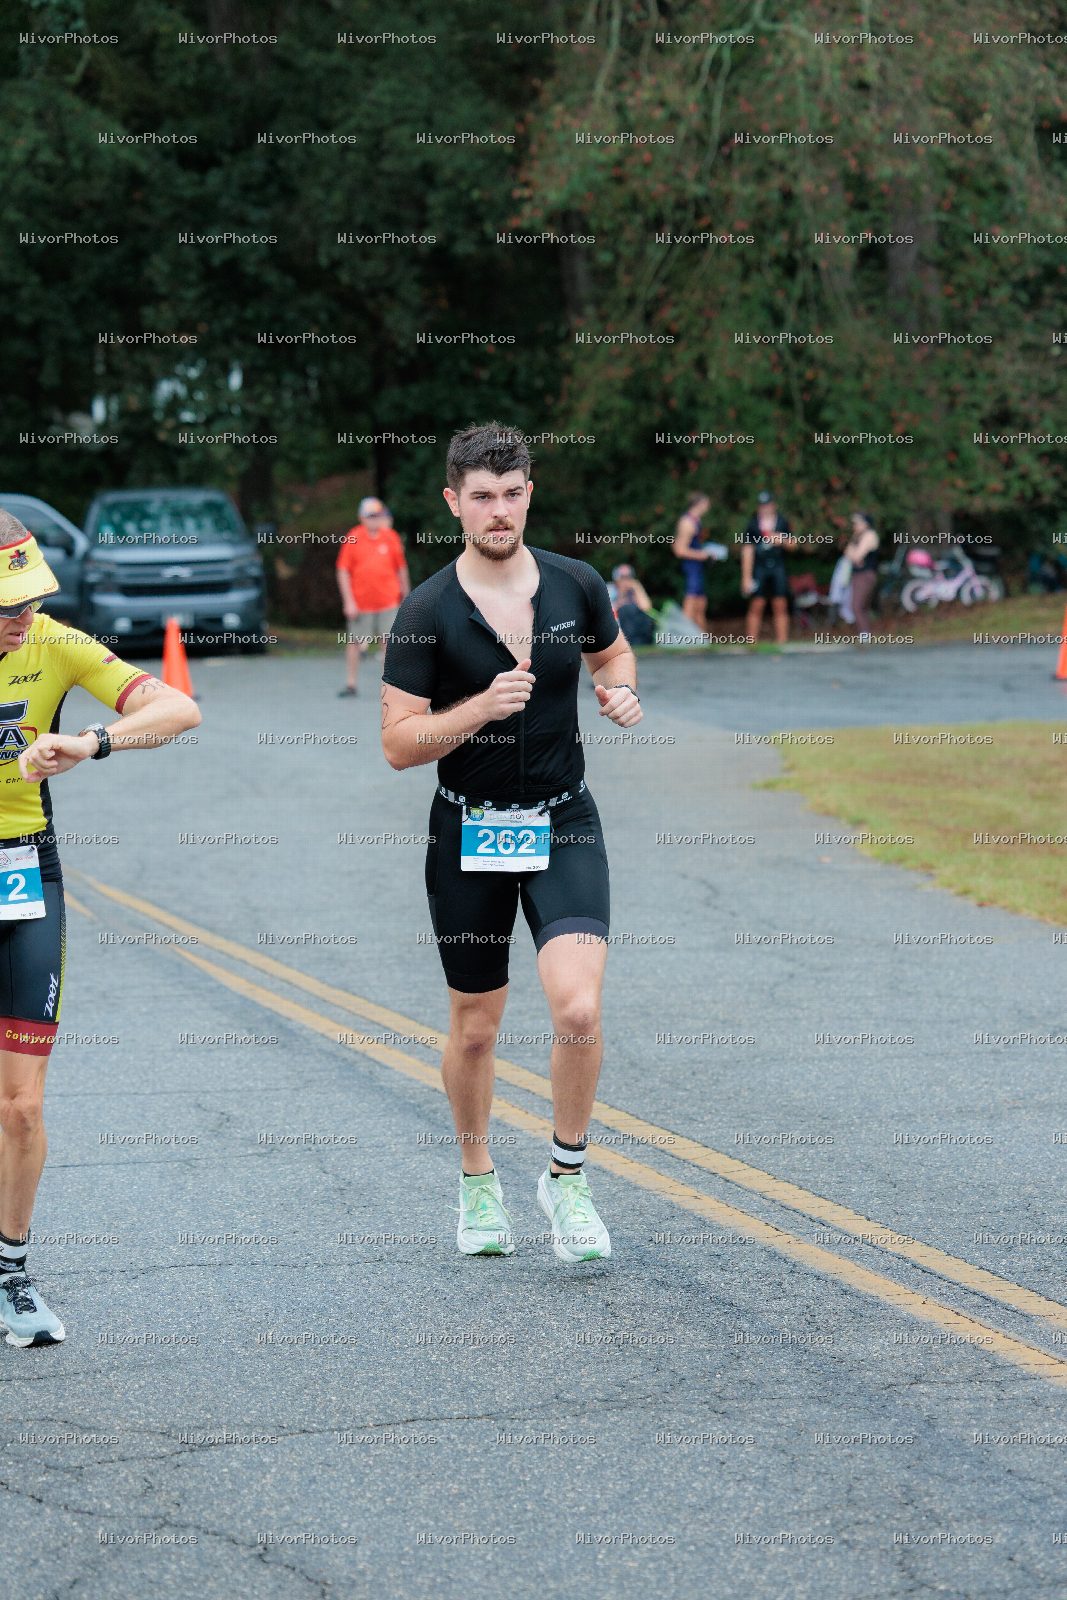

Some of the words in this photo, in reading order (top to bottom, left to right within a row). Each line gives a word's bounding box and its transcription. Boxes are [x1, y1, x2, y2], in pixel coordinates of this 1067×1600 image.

[550, 620, 576, 632] WIXEN
[0, 725, 28, 749] A
[476, 829, 536, 855] 262
[0, 873, 28, 901] 2
